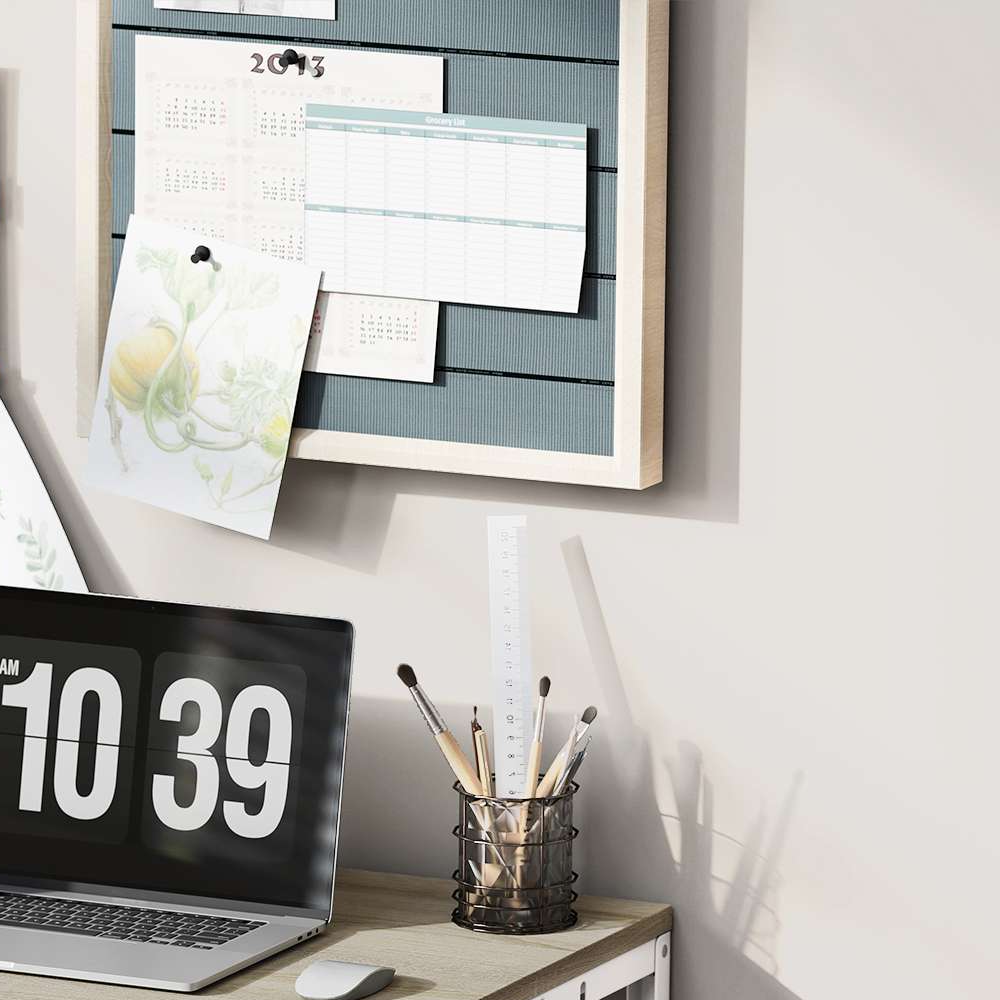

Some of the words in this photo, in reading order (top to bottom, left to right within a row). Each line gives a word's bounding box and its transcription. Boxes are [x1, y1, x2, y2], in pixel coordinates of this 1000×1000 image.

[425, 116, 452, 127] Grocery
[453, 118, 466, 127] List
[2, 662, 123, 821] 10
[152, 677, 293, 839] 39
